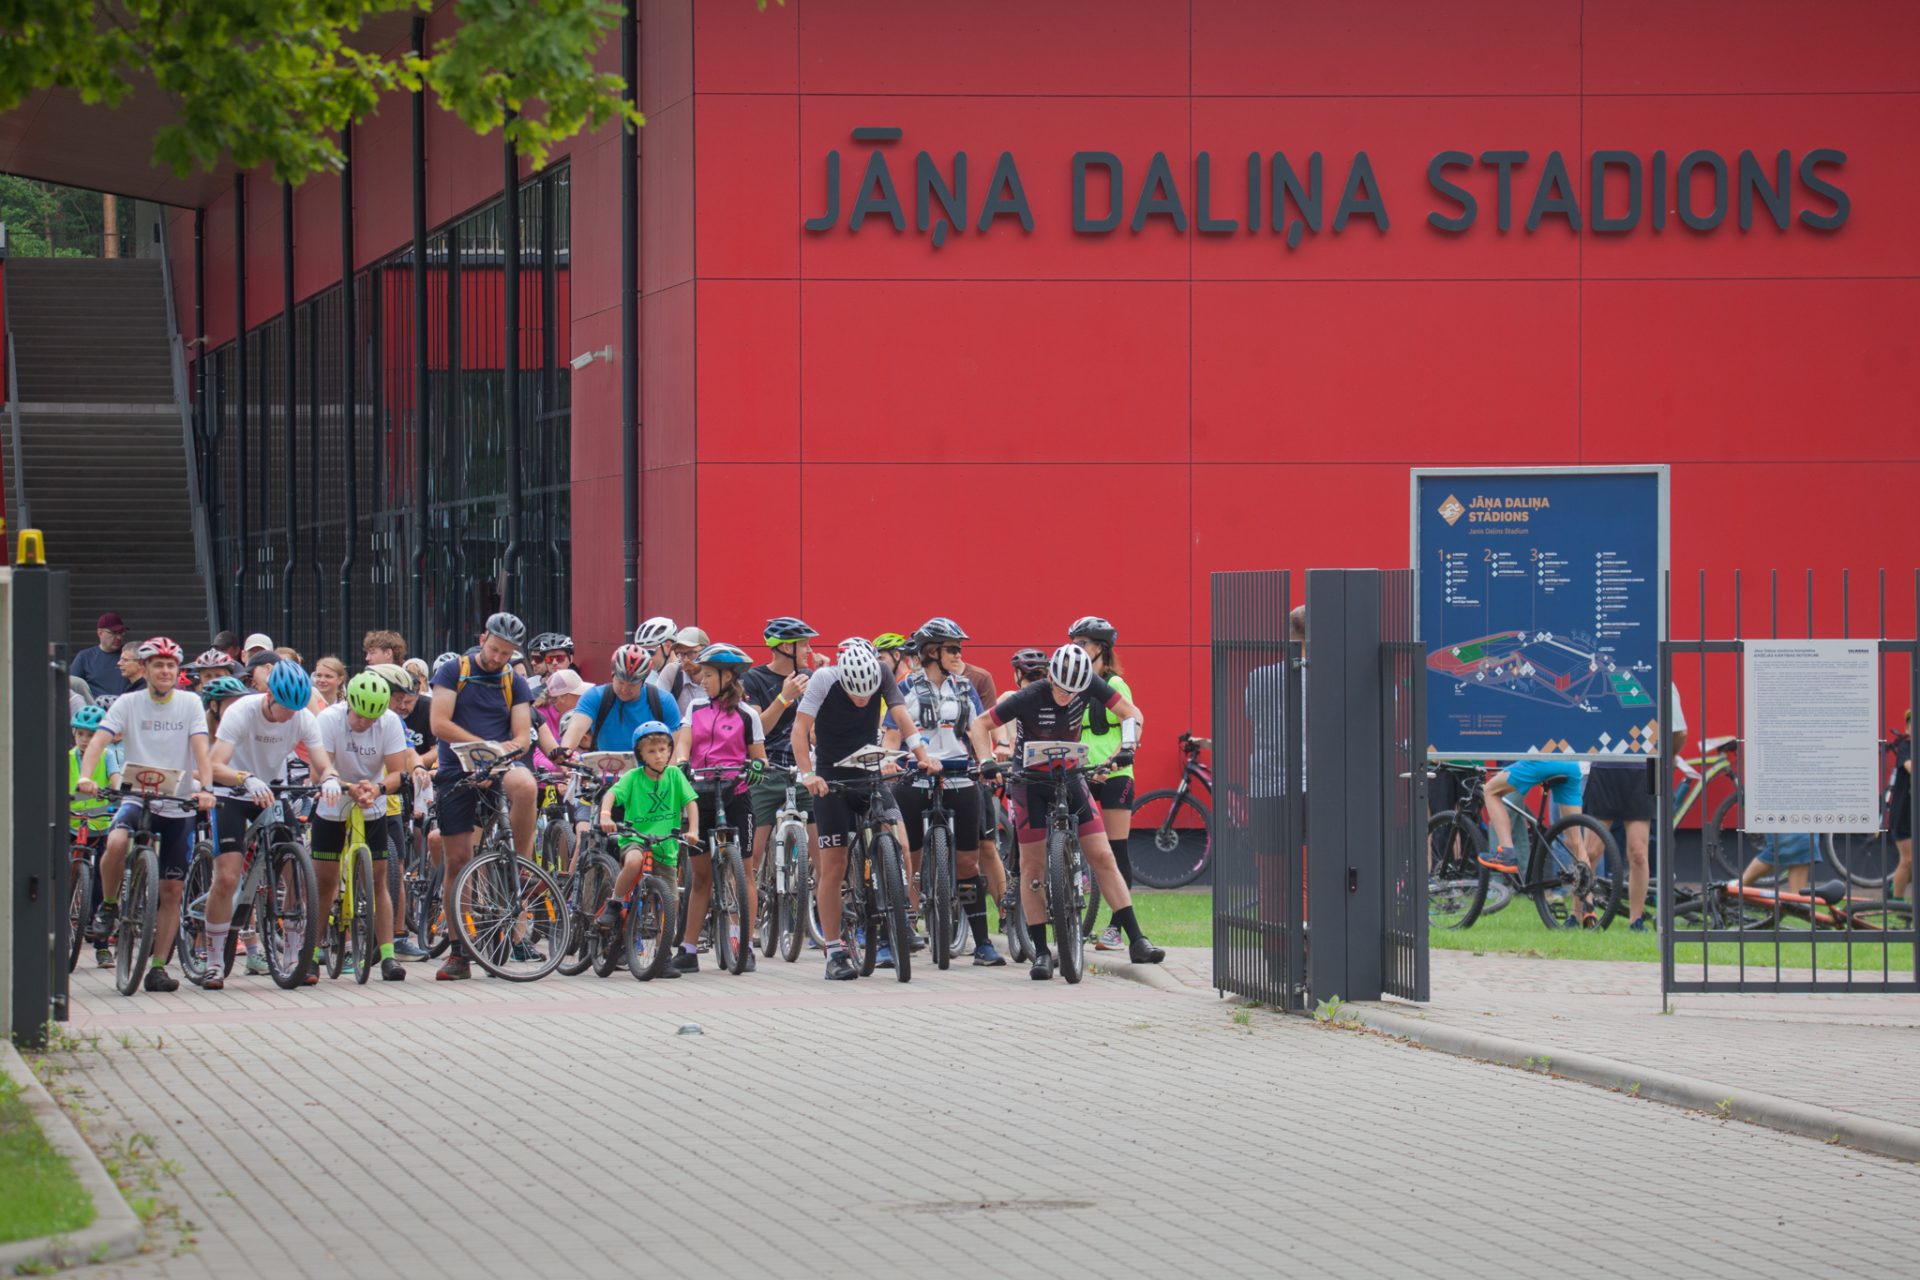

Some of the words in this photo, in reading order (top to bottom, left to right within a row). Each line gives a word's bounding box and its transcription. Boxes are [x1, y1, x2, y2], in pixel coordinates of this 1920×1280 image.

[805, 126, 1035, 247] JĀŅA
[1072, 151, 1390, 249] DALIŅA
[1427, 148, 1851, 233] STADIONS
[1469, 495, 1502, 511] JĀŅA
[1505, 497, 1550, 511] DALIŅA
[1469, 511, 1529, 522] STADIONS
[1438, 549, 1443, 561] 1
[1484, 548, 1492, 561] 2
[1530, 548, 1538, 561] 3
[154, 720, 184, 731] Bitus
